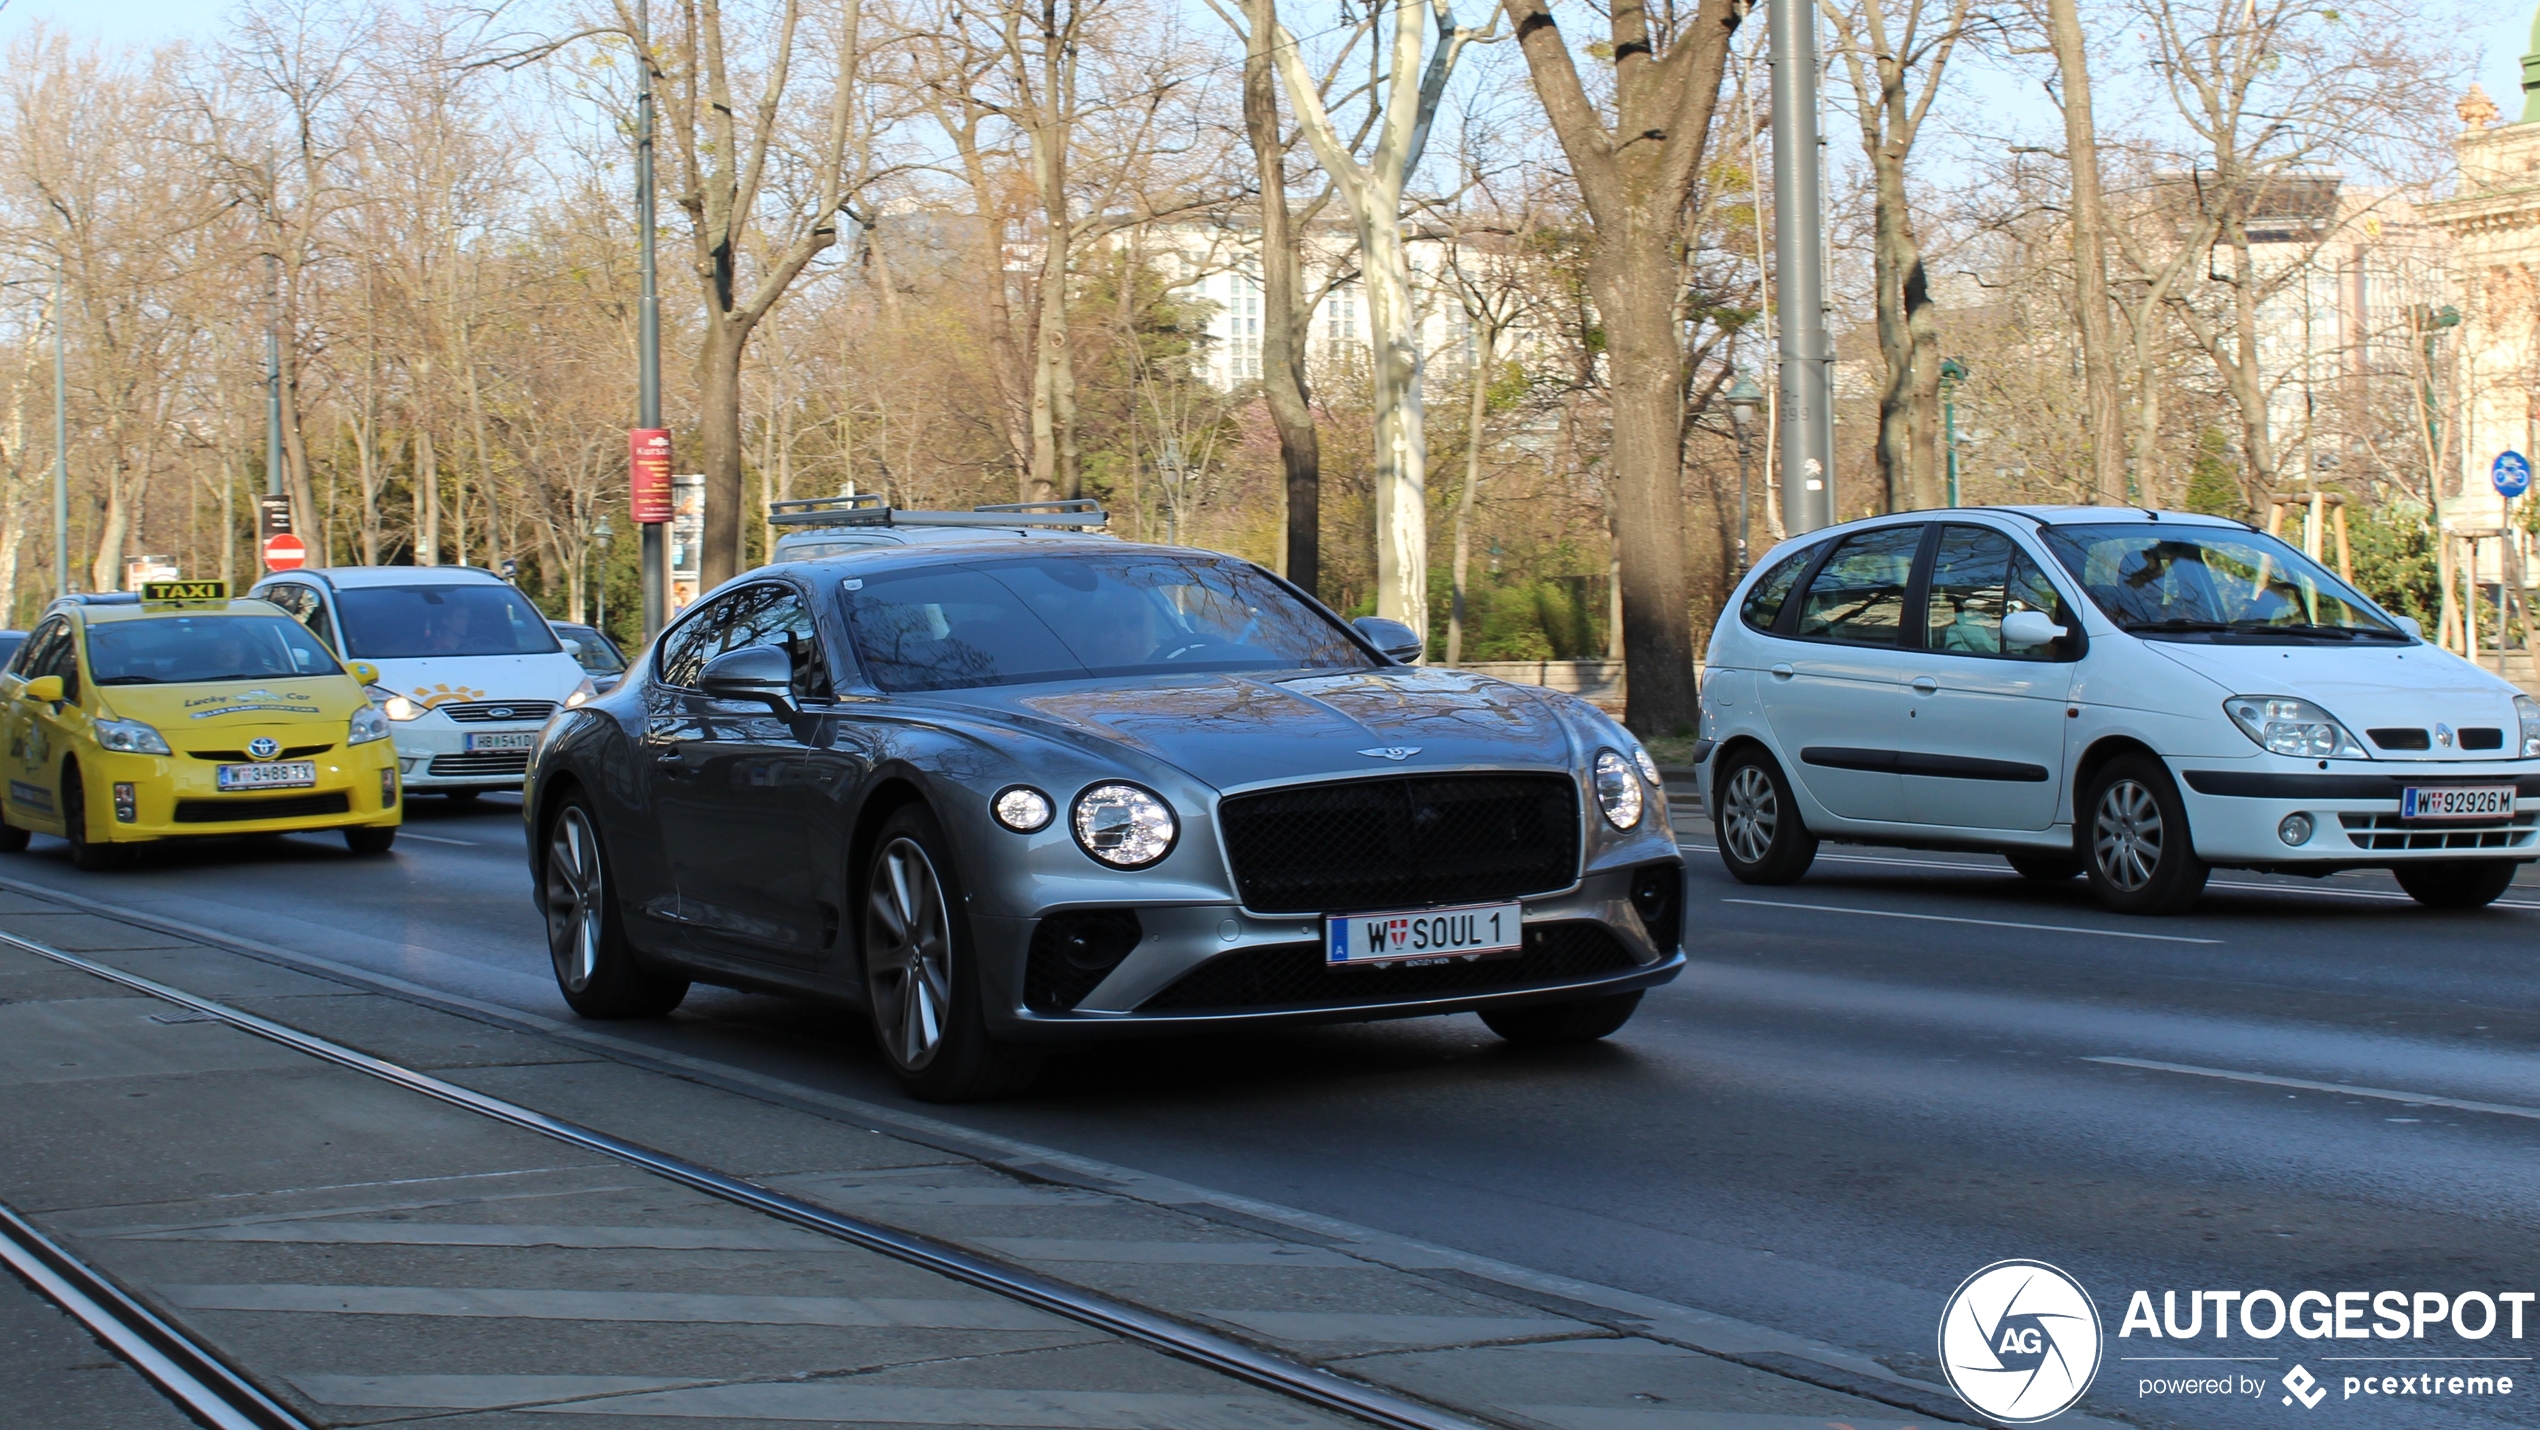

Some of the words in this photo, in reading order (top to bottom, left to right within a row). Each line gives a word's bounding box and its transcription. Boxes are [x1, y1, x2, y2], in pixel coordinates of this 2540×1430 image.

[152, 585, 215, 597] TAXI
[184, 696, 227, 707] Lucky
[286, 692, 311, 700] Car
[253, 766, 288, 781] 3488
[2418, 792, 2431, 813] W
[2444, 791, 2497, 813] 92926
[2499, 791, 2511, 812] M
[1367, 921, 1388, 953] W
[1413, 914, 1482, 949] SOUL
[1489, 911, 1500, 942] 1
